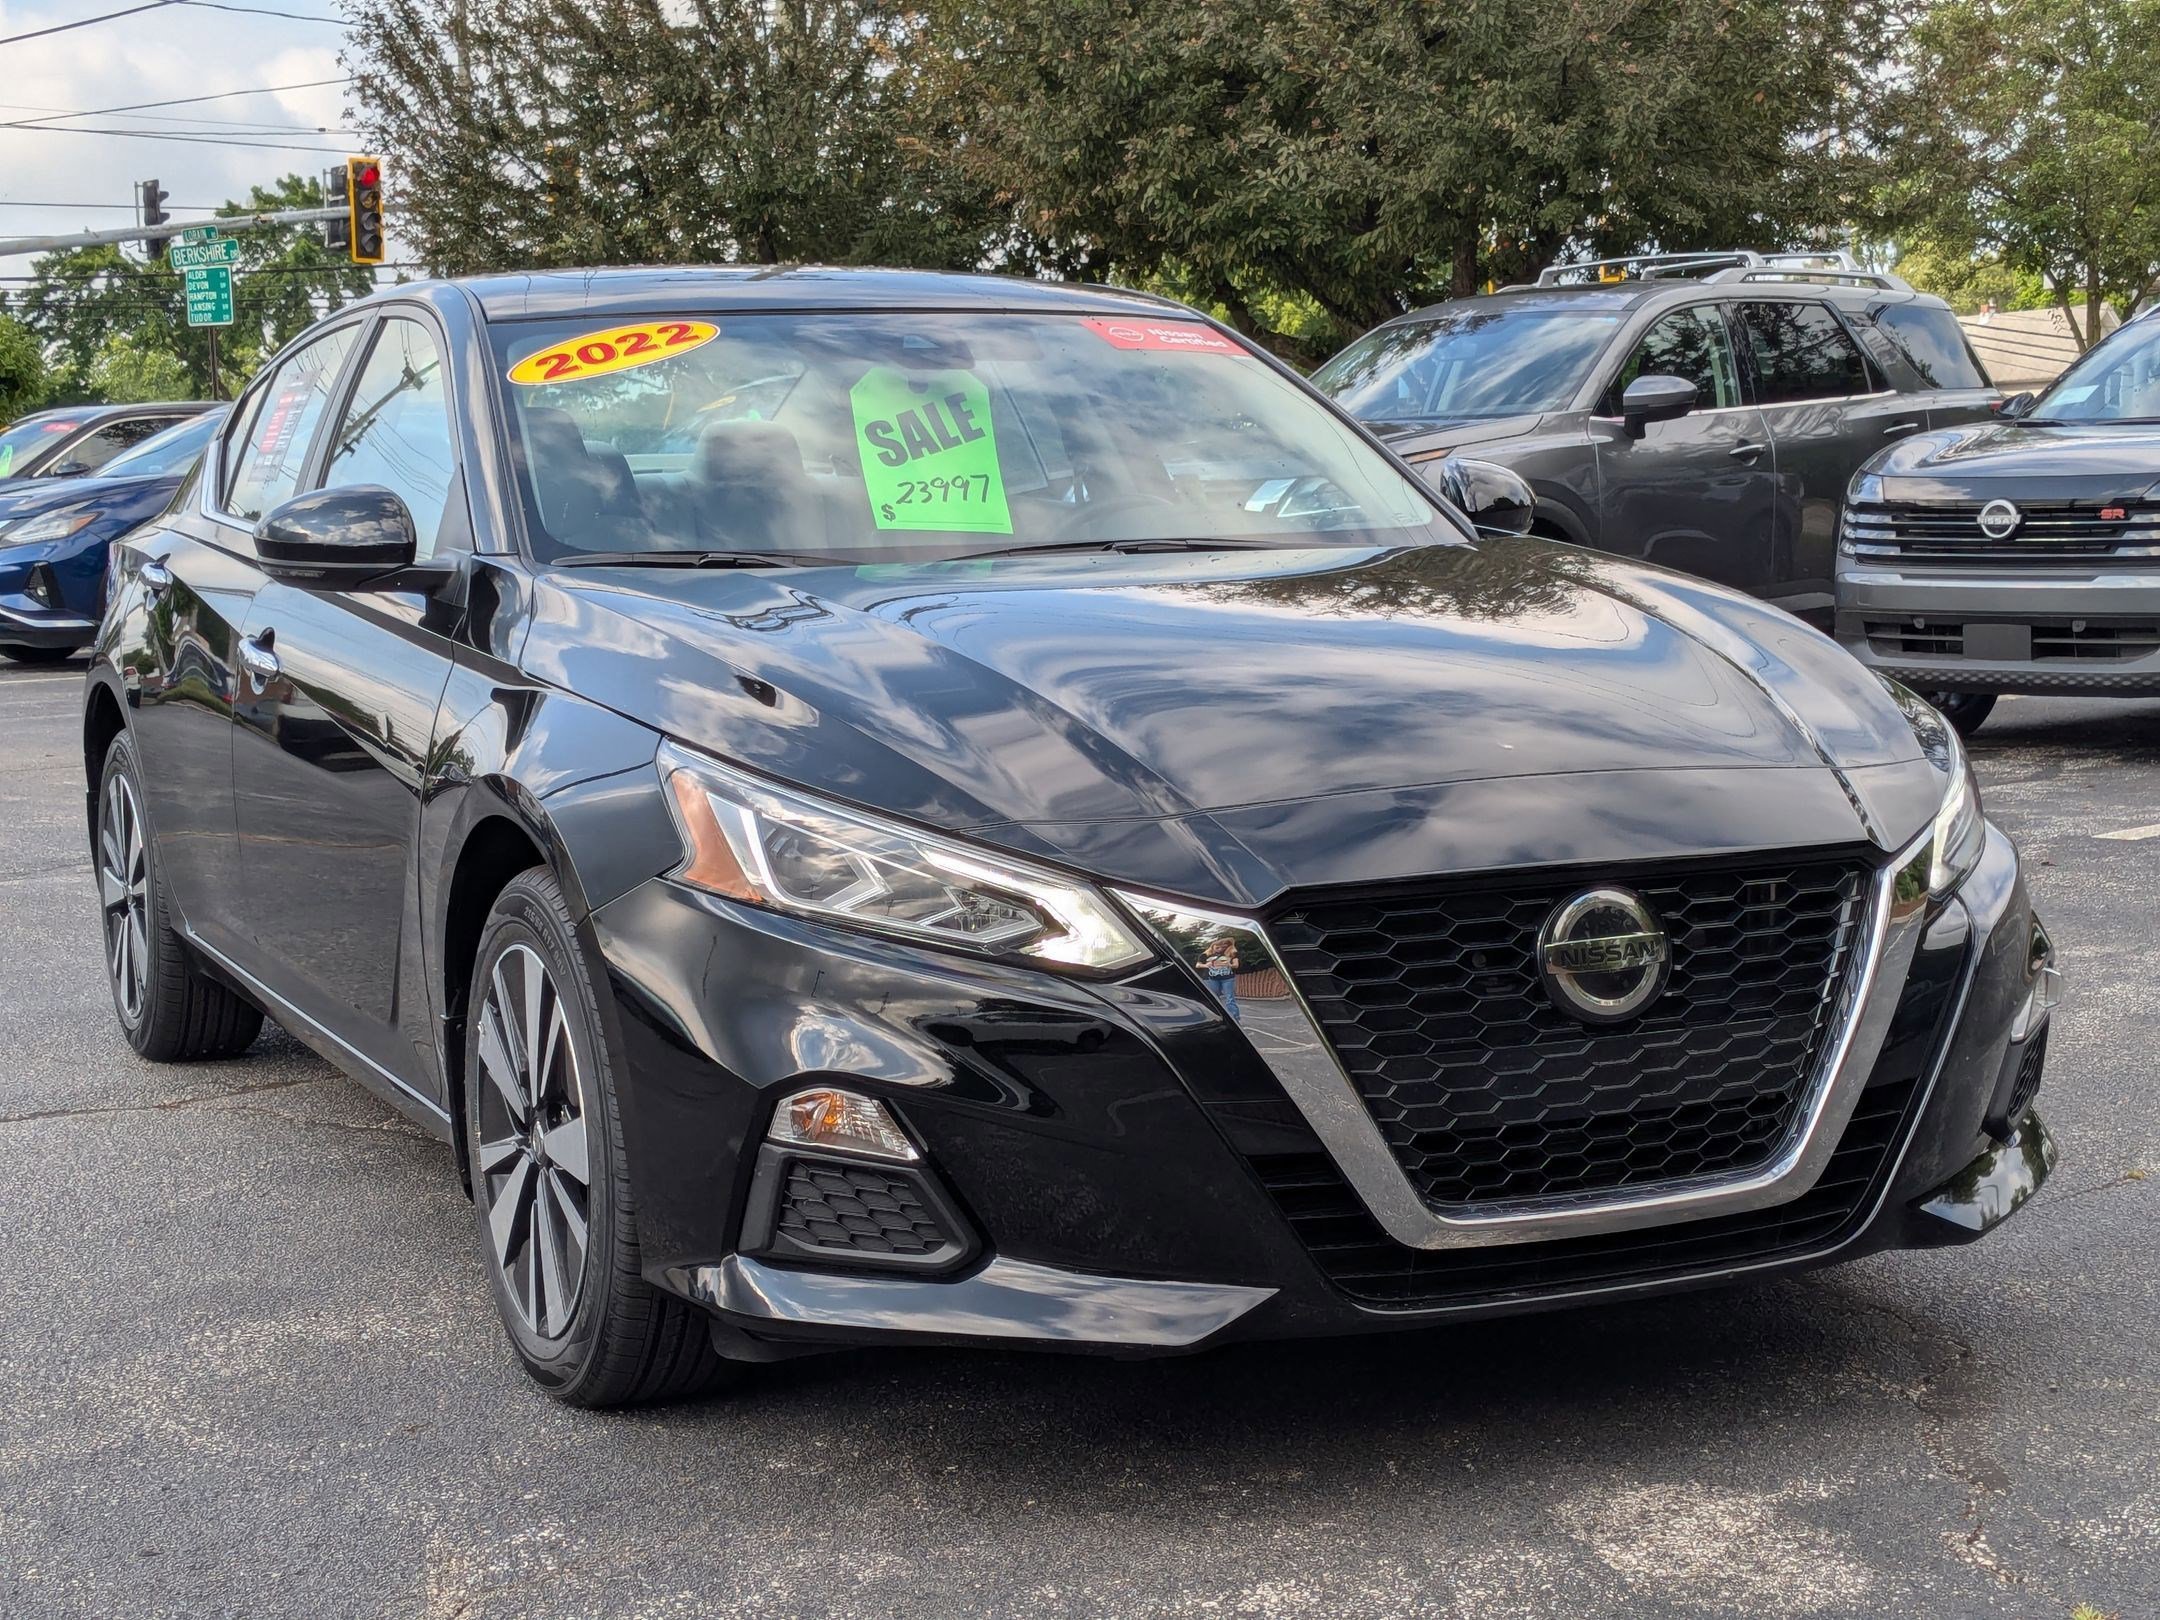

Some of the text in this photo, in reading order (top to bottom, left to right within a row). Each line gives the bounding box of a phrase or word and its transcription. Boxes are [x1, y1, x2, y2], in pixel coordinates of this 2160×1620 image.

[173, 243, 229, 266] BERKSHIRE
[535, 323, 703, 380] 2022
[864, 392, 986, 467] SALE
[880, 473, 990, 522] $ 23997
[1976, 515, 2021, 526] NISSAN
[2100, 507, 2126, 520] SR
[1560, 940, 1657, 966] NISSAN
